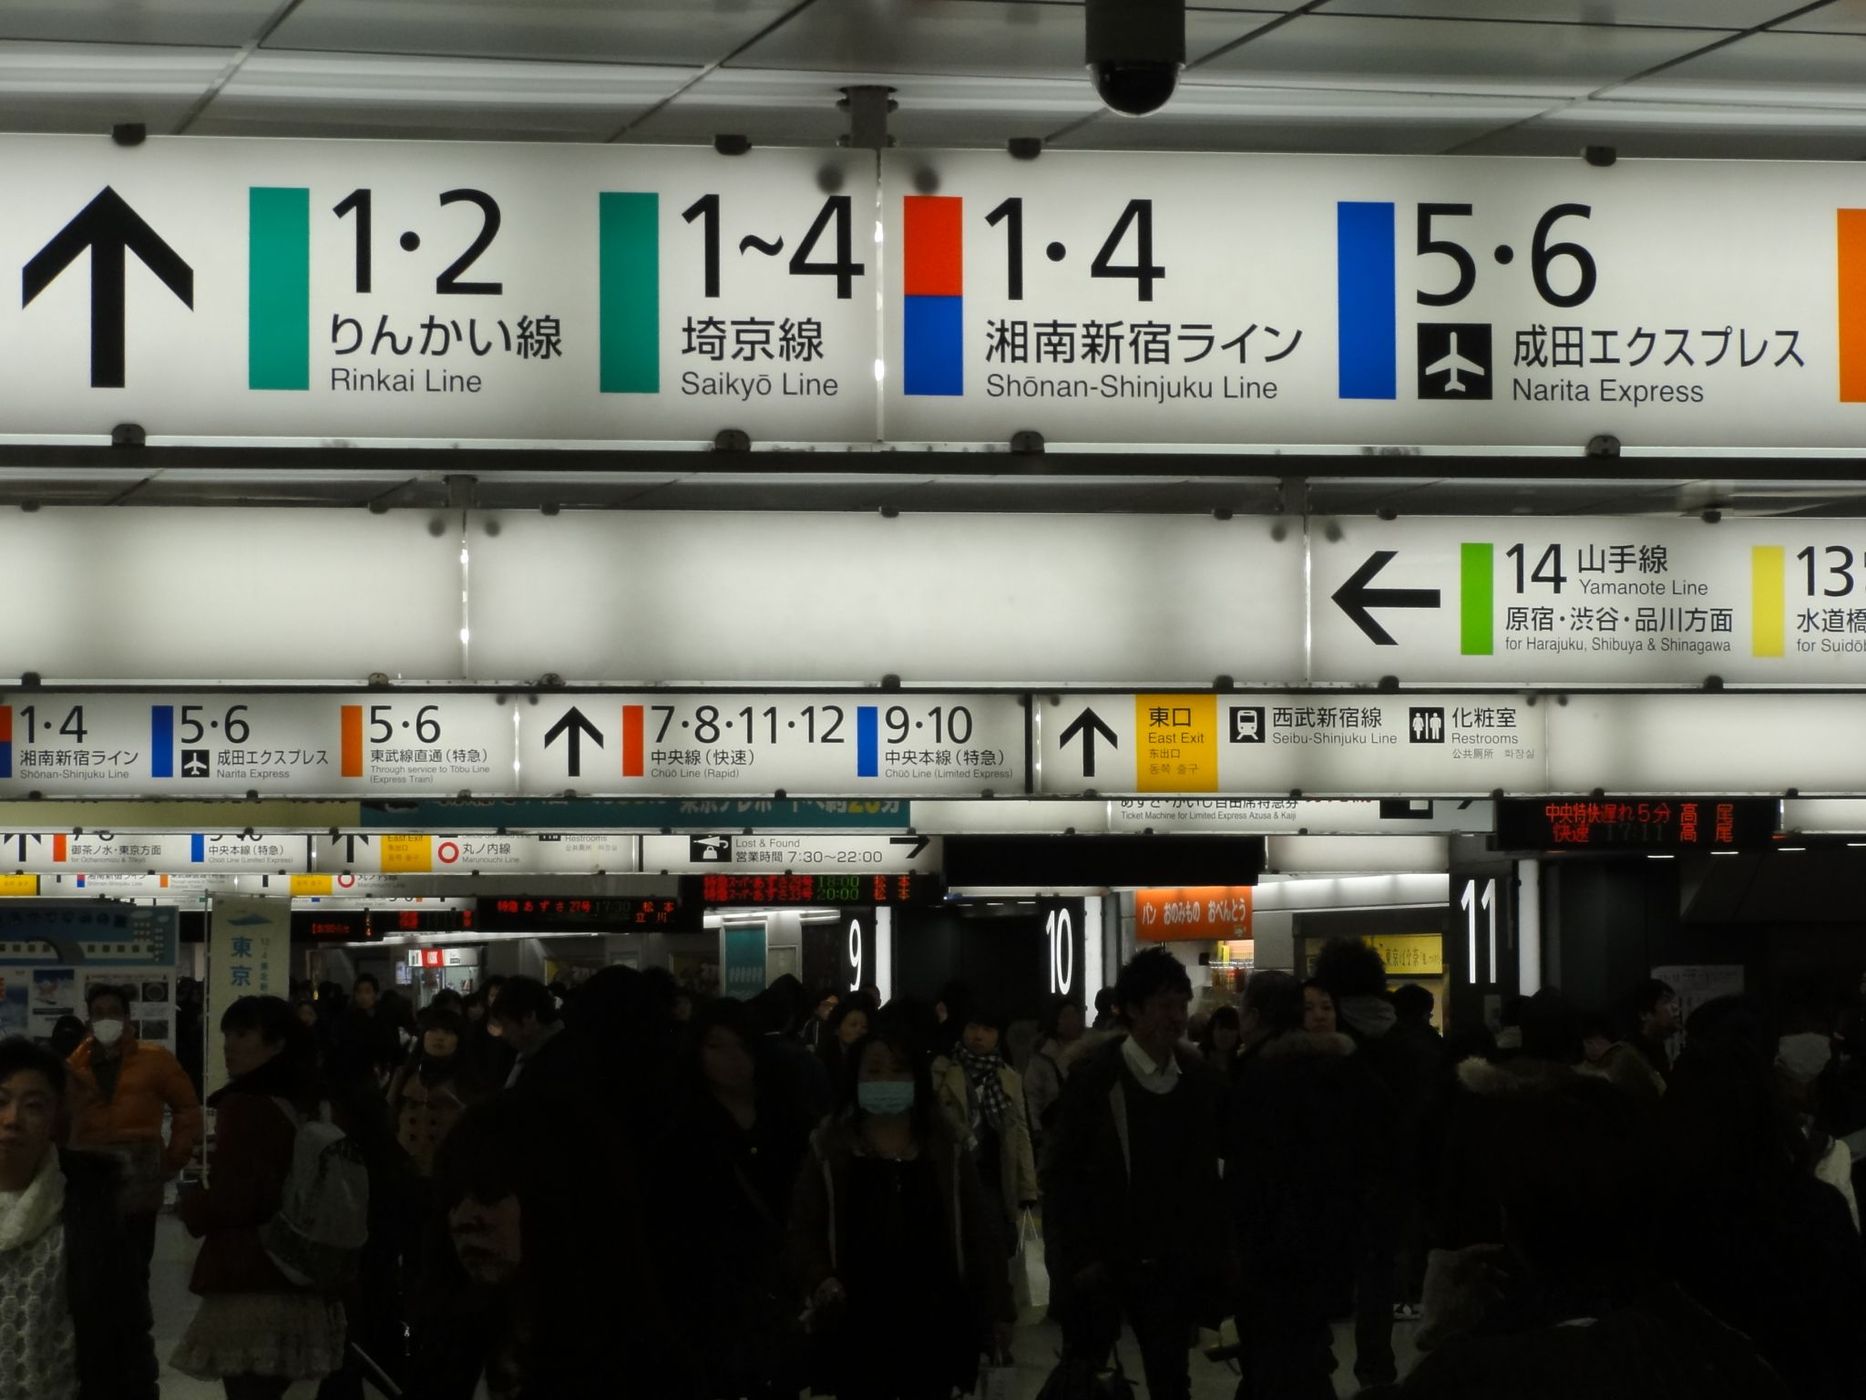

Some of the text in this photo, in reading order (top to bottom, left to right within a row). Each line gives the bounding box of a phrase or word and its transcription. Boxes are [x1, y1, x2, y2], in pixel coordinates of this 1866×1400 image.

[332, 314, 563, 360] りんかい線
[682, 316, 824, 362] 埼京線
[986, 319, 1302, 365] 湘南新宿ライン
[1513, 323, 1804, 368] 成田エクスプレス
[332, 368, 482, 393] Rinkai Line
[681, 371, 838, 402] Saikyō Line
[987, 373, 1277, 404] Shōnan-Shinjuku Line
[1513, 378, 1703, 408] Narita Express
[1506, 543, 1567, 594] 14
[1578, 544, 1668, 574] 山手線
[1797, 545, 1854, 597] 13
[1579, 579, 1708, 595] Yamanote Line
[1506, 606, 1733, 633] 原宿・渋谷・品川方面
[1797, 608, 1866, 633] 水道橋
[1505, 637, 1731, 655] for Harajuku, Shibuya & Shinagawa
[1797, 638, 1866, 652] for Suidō
[1149, 706, 1192, 728] 東口
[1272, 704, 1381, 728] 西武新宿線
[1452, 707, 1516, 728] 化粧室
[1148, 733, 1205, 745] East Exit
[1272, 733, 1398, 748] Seibu-Shinjuku Line
[1451, 732, 1518, 744] Restrooms
[19, 749, 138, 766] 湘南新宿ライン
[218, 749, 329, 766] 成田エクスプレス
[108, 770, 129, 779] Line
[217, 769, 290, 782] Narita Express
[371, 765, 406, 775] Through
[407, 765, 438, 775] service
[439, 765, 449, 774] to
[472, 765, 491, 774] Line
[678, 769, 700, 778] Line
[703, 768, 739, 781] (Rapid)
[912, 769, 932, 778] Line
[934, 768, 972, 780] (Limited
[974, 768, 1014, 781] Express)
[1121, 811, 1297, 822] Ticket Machine for Limited Express Azusa & Kaiji
[463, 843, 511, 855] 丸ノ内線
[735, 838, 800, 848] Lost & Found
[735, 851, 783, 863] 営業時間
[1460, 877, 1497, 984] 11
[849, 918, 862, 992] 9
[1046, 908, 1073, 995] 10
